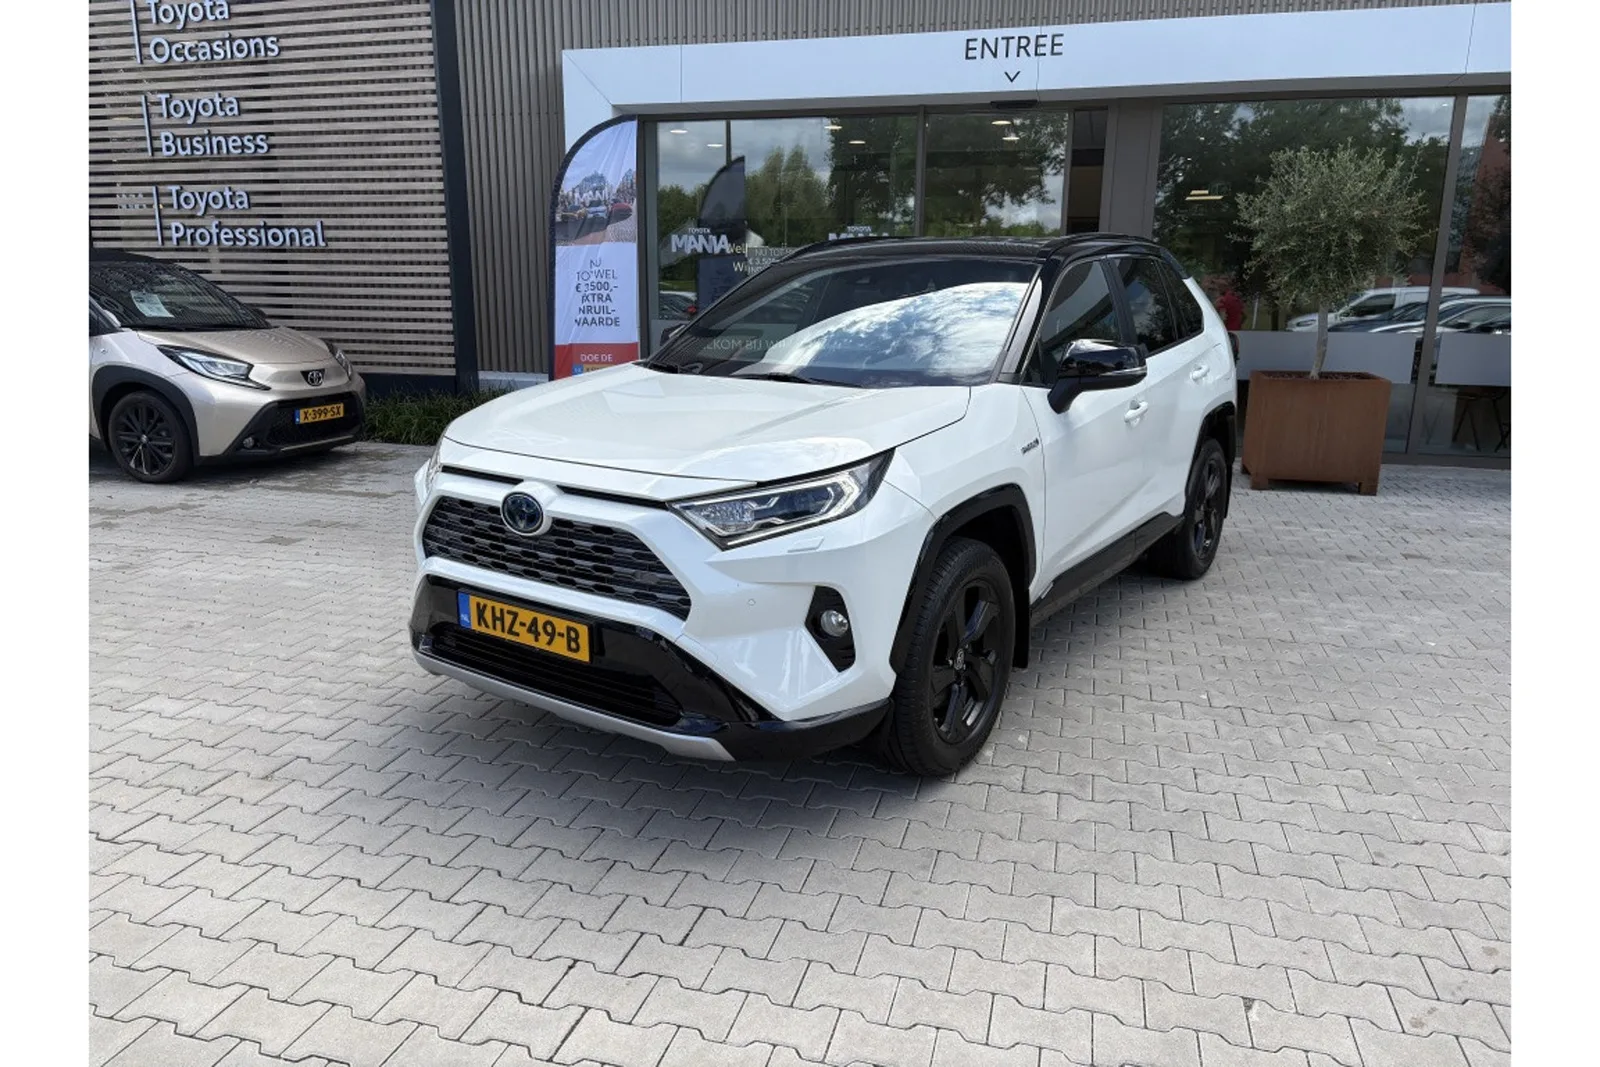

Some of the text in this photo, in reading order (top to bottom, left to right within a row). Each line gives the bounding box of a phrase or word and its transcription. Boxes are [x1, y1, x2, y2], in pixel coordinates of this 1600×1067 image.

[147, 0, 230, 30] Toyota
[149, 33, 280, 63] Occasions
[965, 33, 1064, 60] ENTREE
[157, 92, 239, 124] Toyota
[160, 129, 269, 156] Business
[166, 185, 250, 216] Toyota
[171, 220, 327, 247] Professional
[671, 234, 729, 255] MANIA
[594, 269, 618, 280] WEL
[580, 353, 613, 362] DOE DE
[303, 405, 342, 421] X-399-SX
[476, 601, 581, 654] KHZ-49-B
